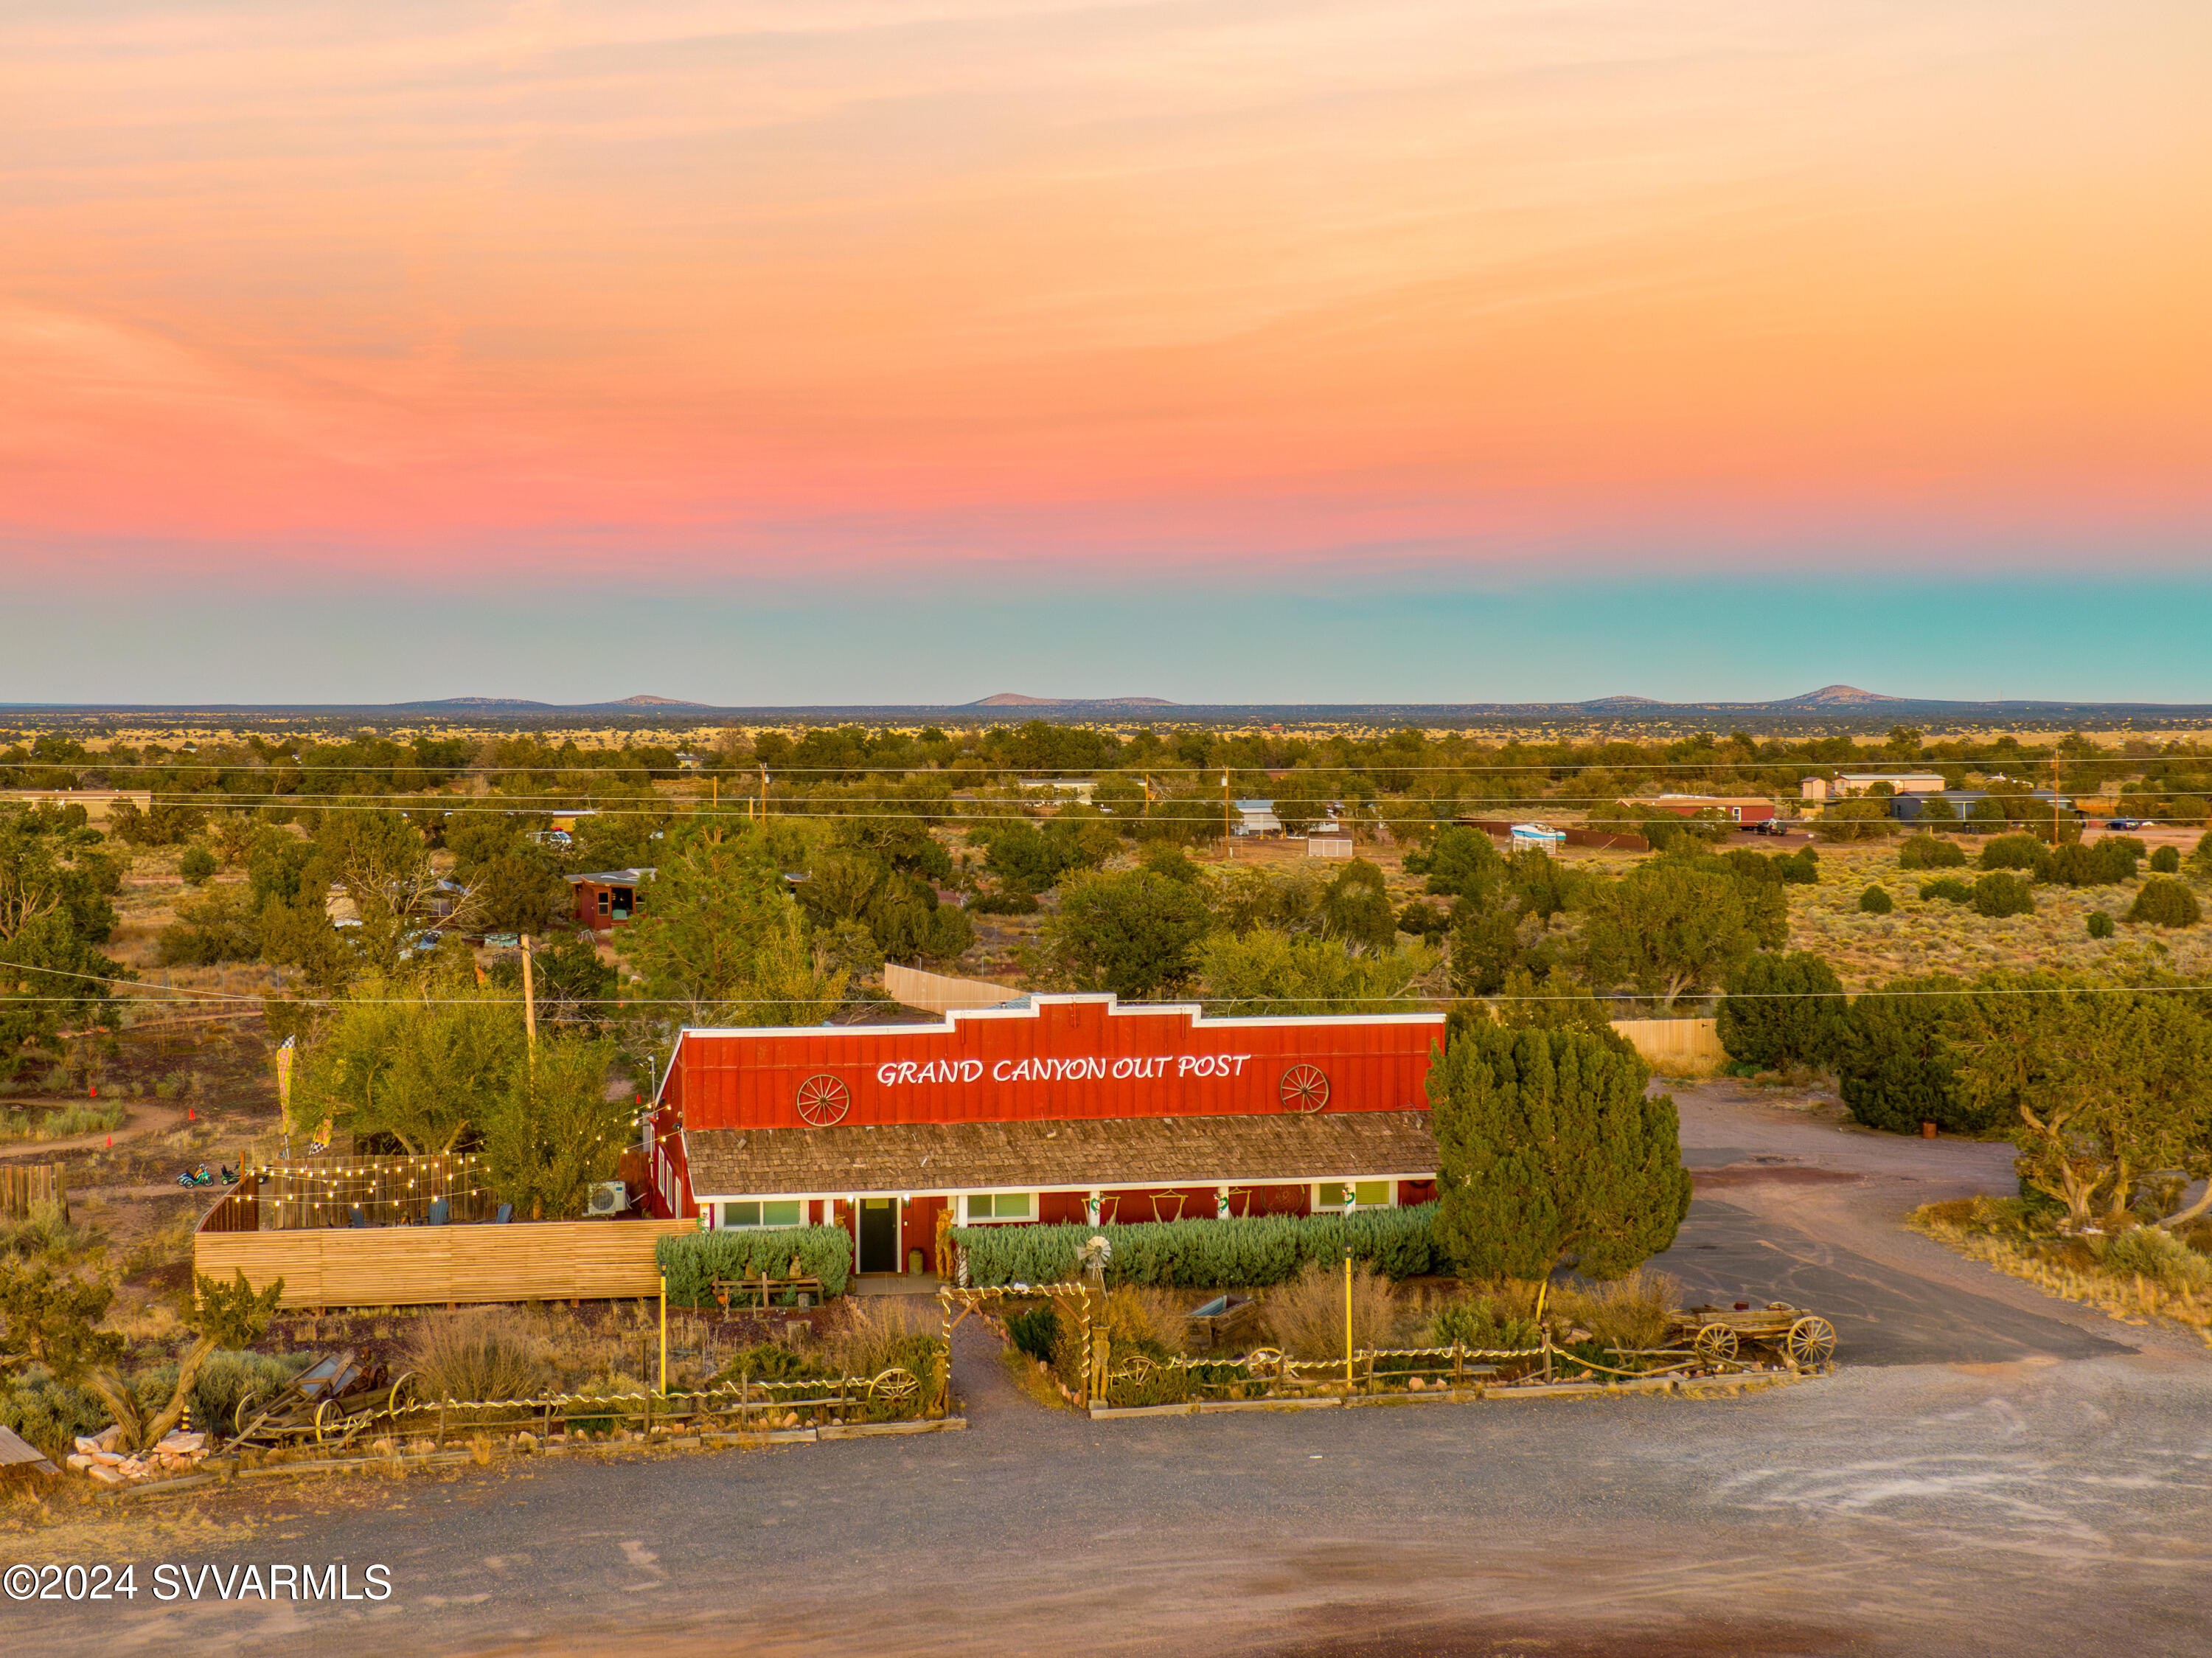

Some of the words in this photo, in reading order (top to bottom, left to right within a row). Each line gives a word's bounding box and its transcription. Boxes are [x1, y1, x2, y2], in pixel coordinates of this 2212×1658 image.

[877, 1060, 984, 1086] GRAND
[993, 1057, 1106, 1081] CANYON
[1113, 1056, 1173, 1078] OUT
[1178, 1055, 1251, 1076] POST
